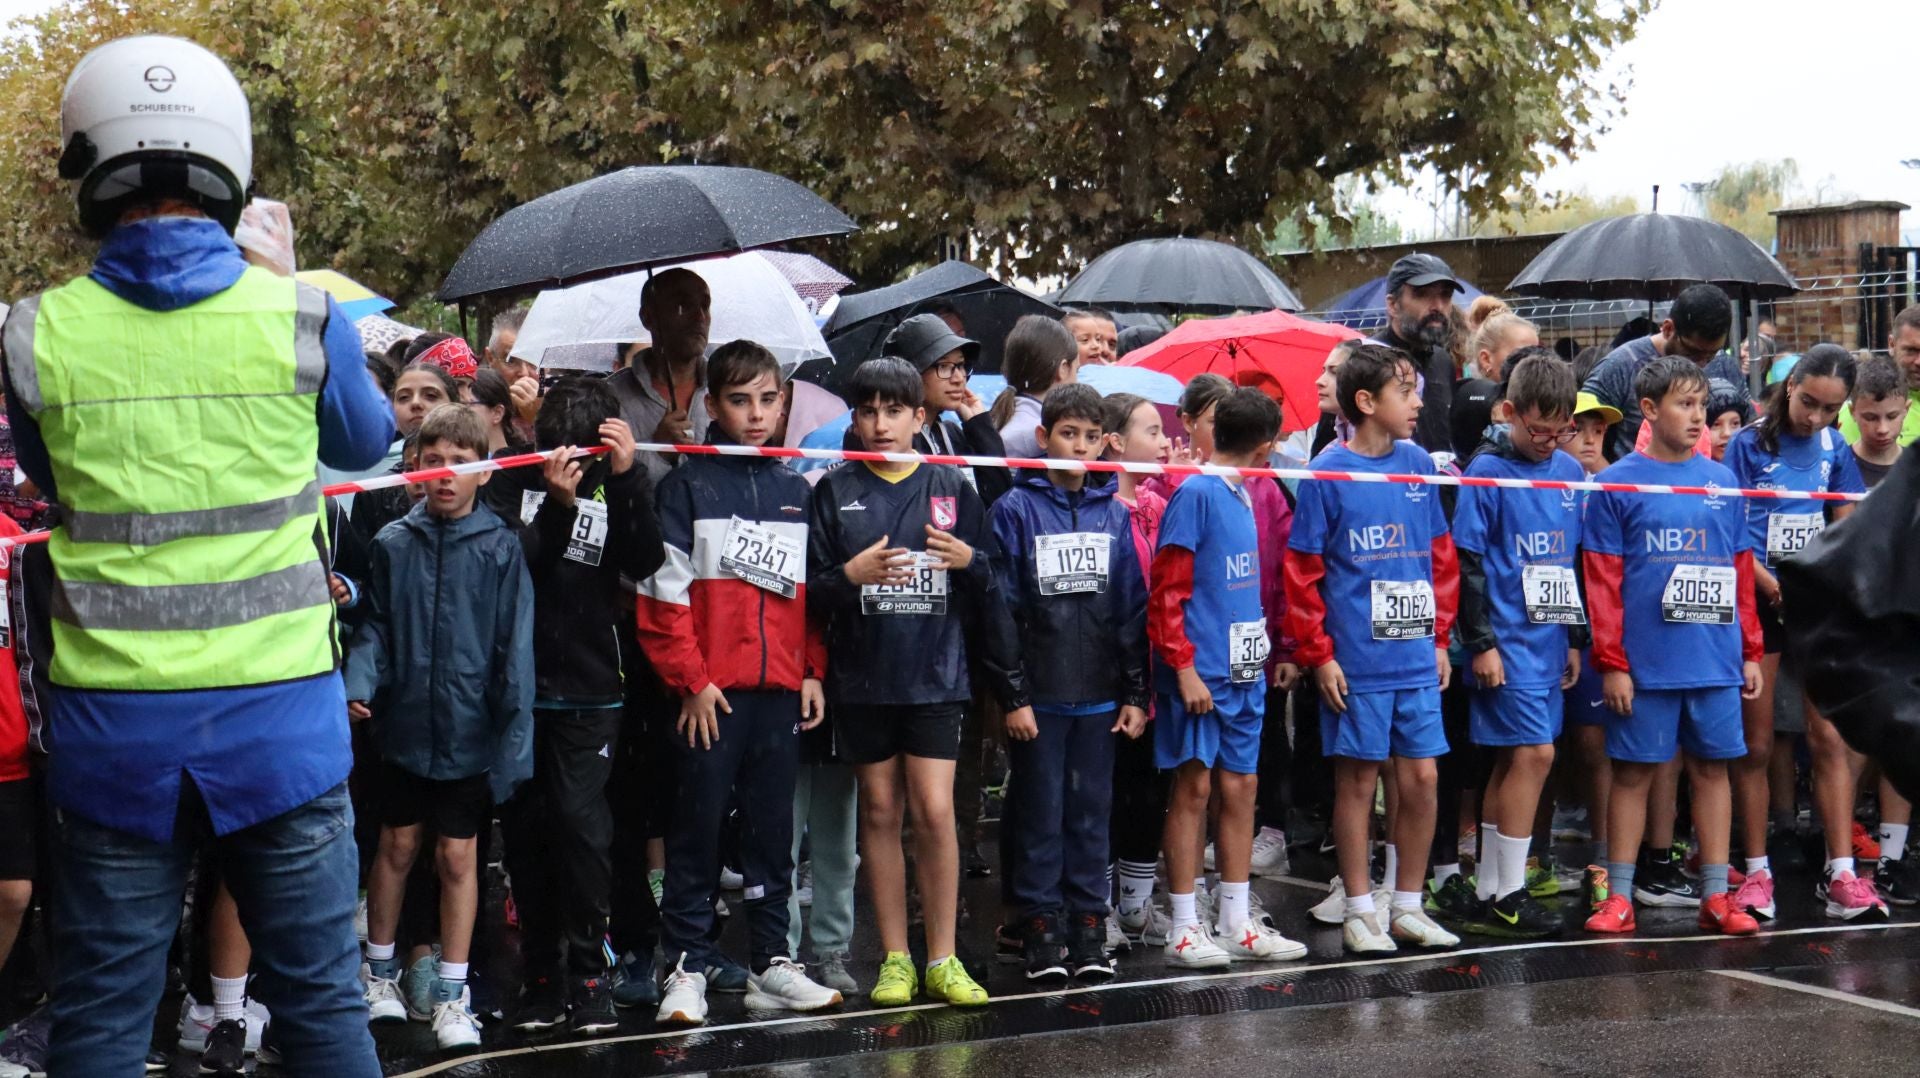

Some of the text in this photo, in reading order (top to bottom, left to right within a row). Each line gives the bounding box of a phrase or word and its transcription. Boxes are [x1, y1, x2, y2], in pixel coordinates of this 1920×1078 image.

[130, 104, 195, 113] SCHUBERTH
[1348, 523, 1406, 552] NB21
[1515, 530, 1566, 557] NB21
[1645, 528, 1707, 552] NB21
[734, 536, 788, 573] 2347
[1057, 547, 1096, 573] 1129
[1226, 551, 1259, 580] NB2
[747, 573, 784, 591] HYUNDAI
[1071, 580, 1098, 588] HYUND
[1673, 579, 1721, 604] 3063
[1385, 595, 1427, 619] 3062
[1686, 612, 1720, 620] HYUNDAI
